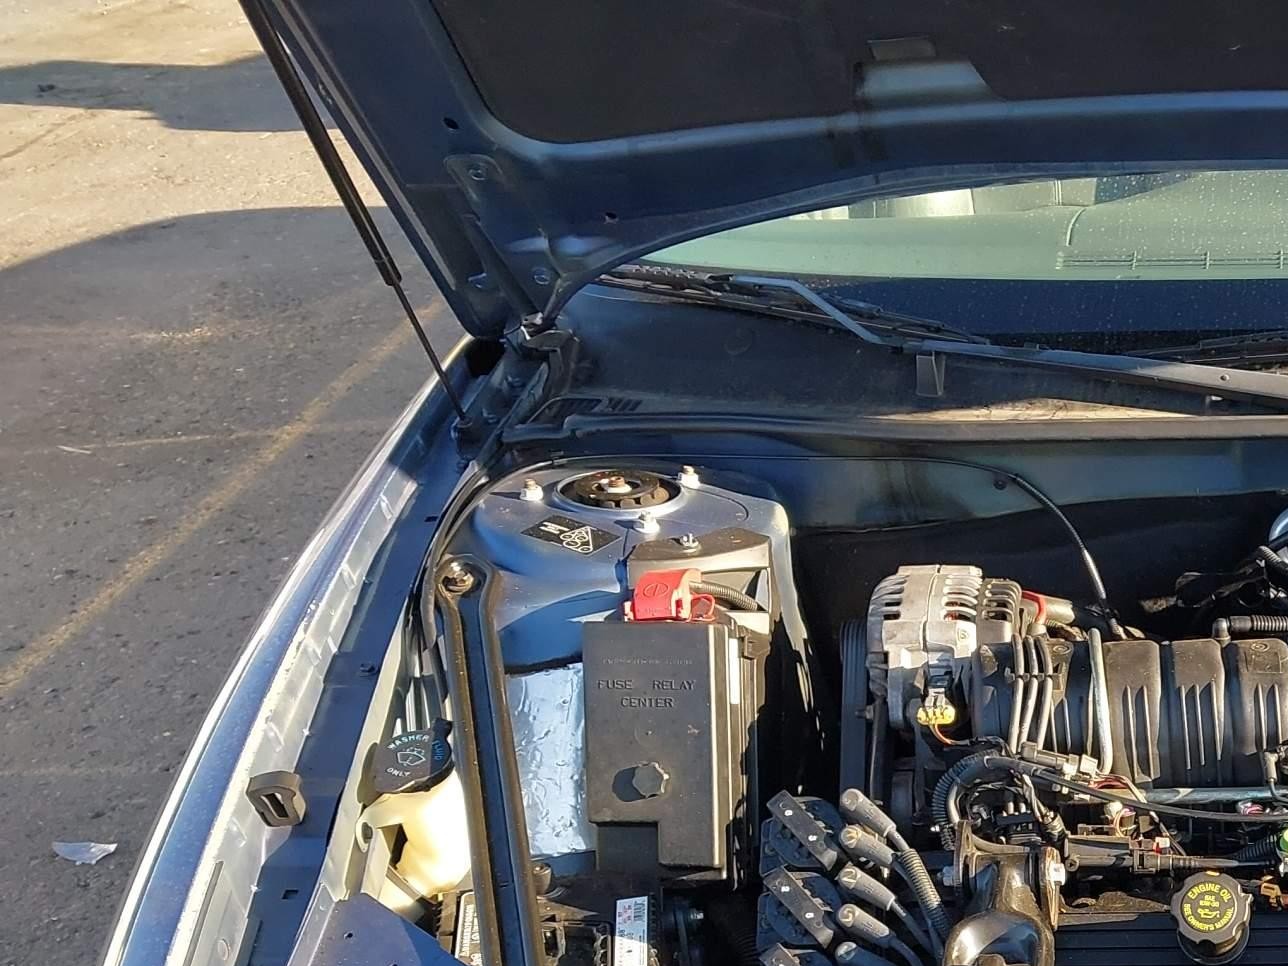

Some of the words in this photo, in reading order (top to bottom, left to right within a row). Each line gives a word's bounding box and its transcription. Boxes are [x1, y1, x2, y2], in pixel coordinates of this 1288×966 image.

[597, 680, 633, 690] FUSE
[652, 680, 696, 691] RELAY
[620, 696, 673, 708] CENTER
[386, 734, 431, 750] WASHER
[386, 767, 411, 777] ONLY
[1187, 883, 1221, 900] ENGINE
[1220, 889, 1232, 903] OIL
